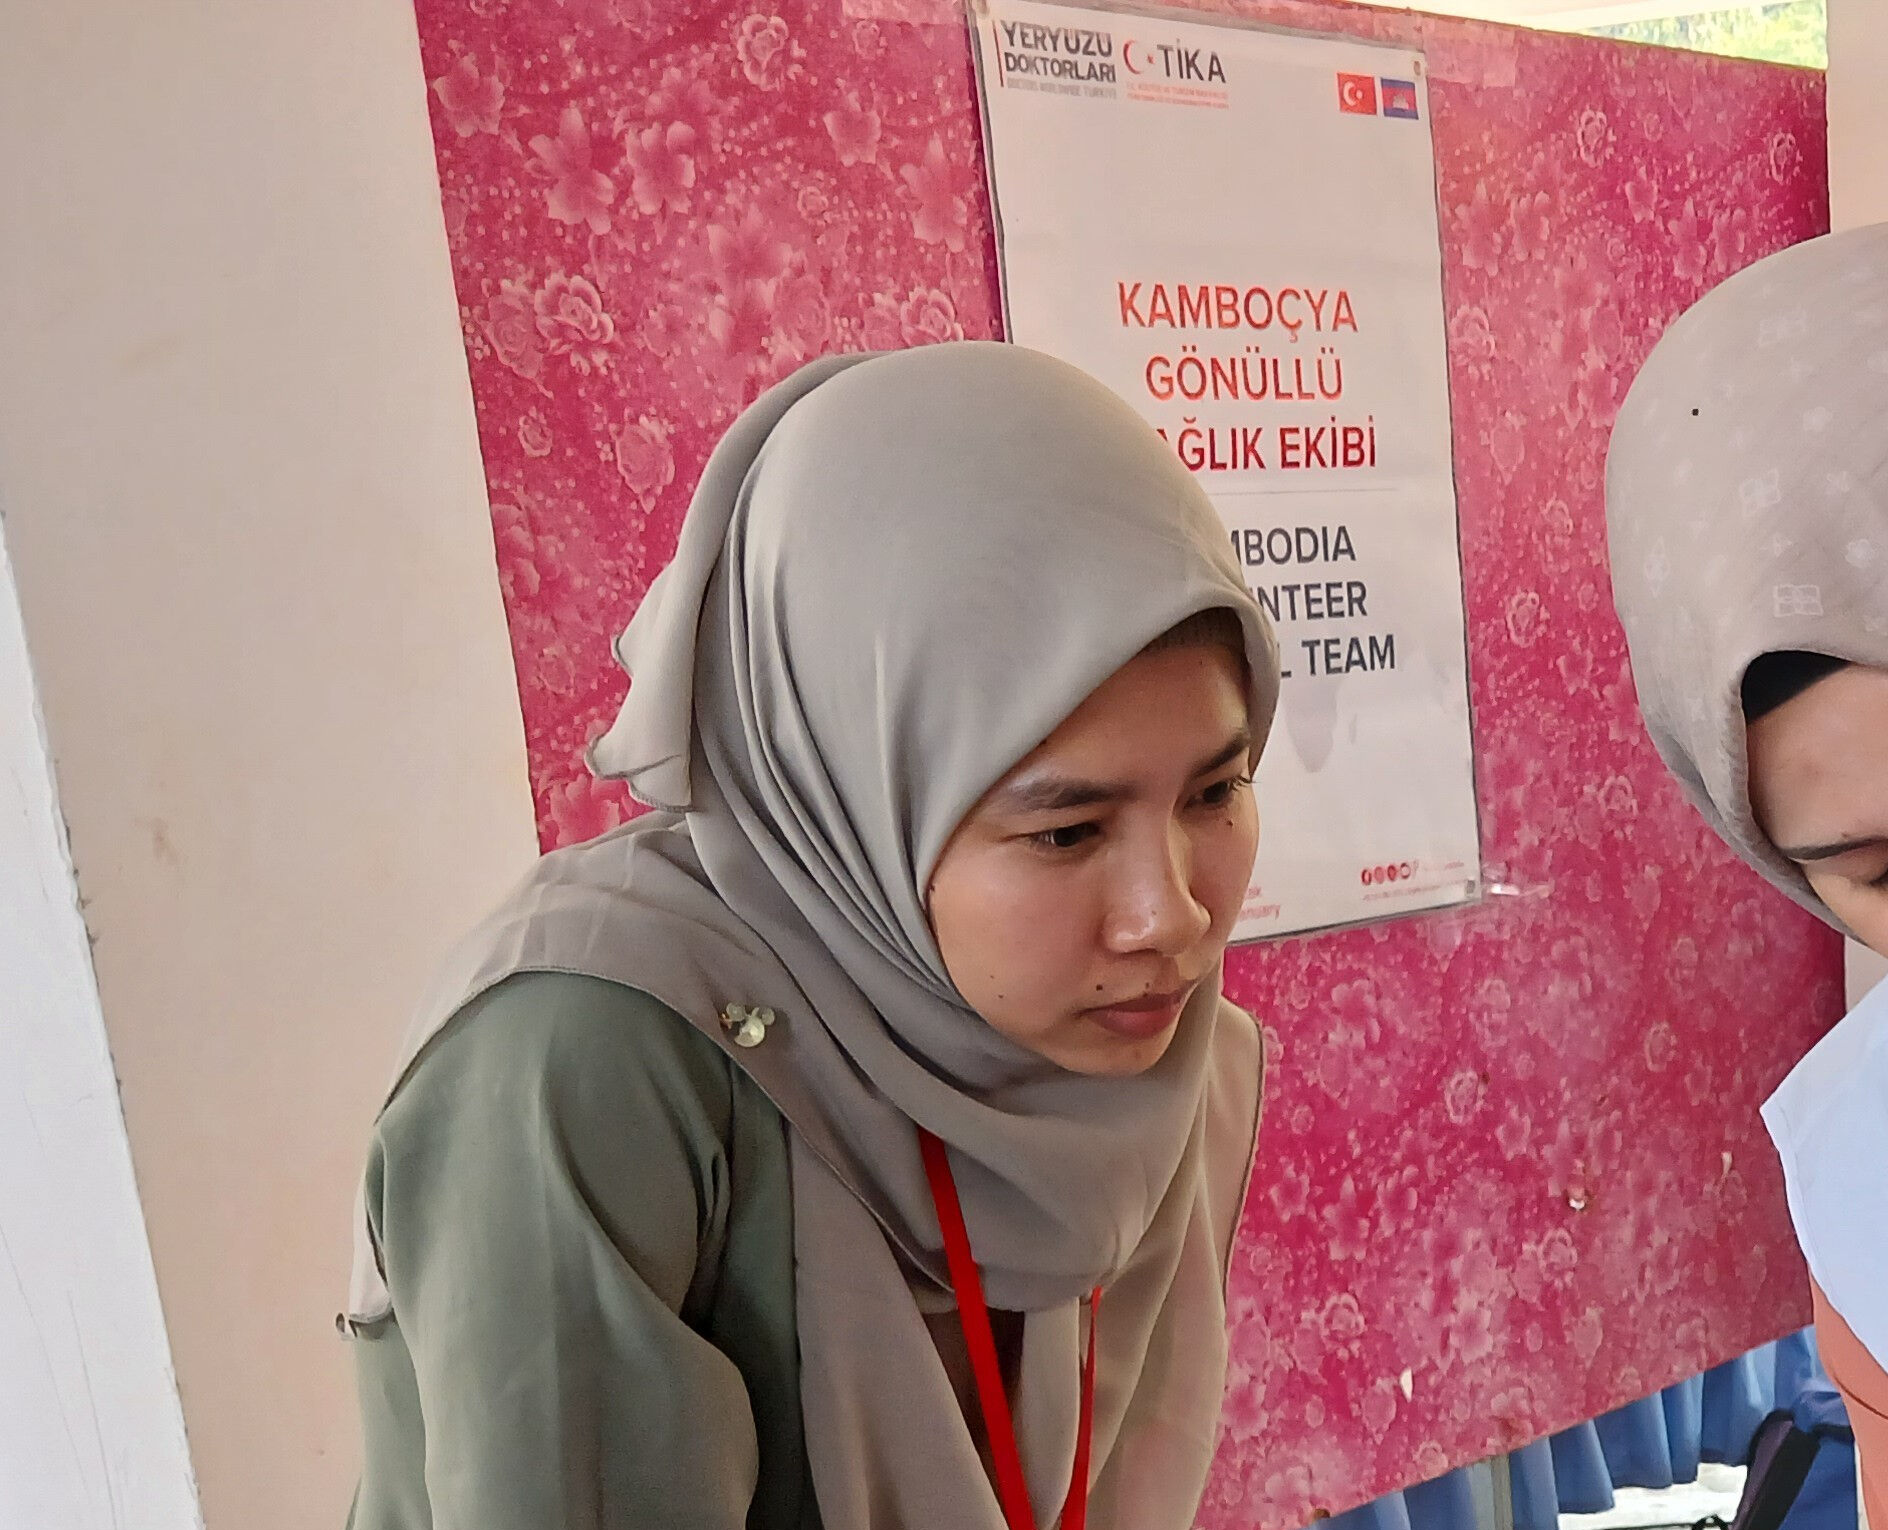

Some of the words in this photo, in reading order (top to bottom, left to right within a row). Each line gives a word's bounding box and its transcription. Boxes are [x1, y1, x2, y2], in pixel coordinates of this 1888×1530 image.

[1004, 52, 1117, 83] DOKTORLARI
[1156, 38, 1227, 83] TİKA
[1118, 282, 1358, 343] KAMBOÇYA
[1145, 345, 1343, 400] GÖNÜLLÜ
[1157, 416, 1267, 472] ĞLIK
[1279, 415, 1376, 470] EKİBİ
[1251, 581, 1368, 622] NTEER
[1302, 633, 1396, 676] TEAM
